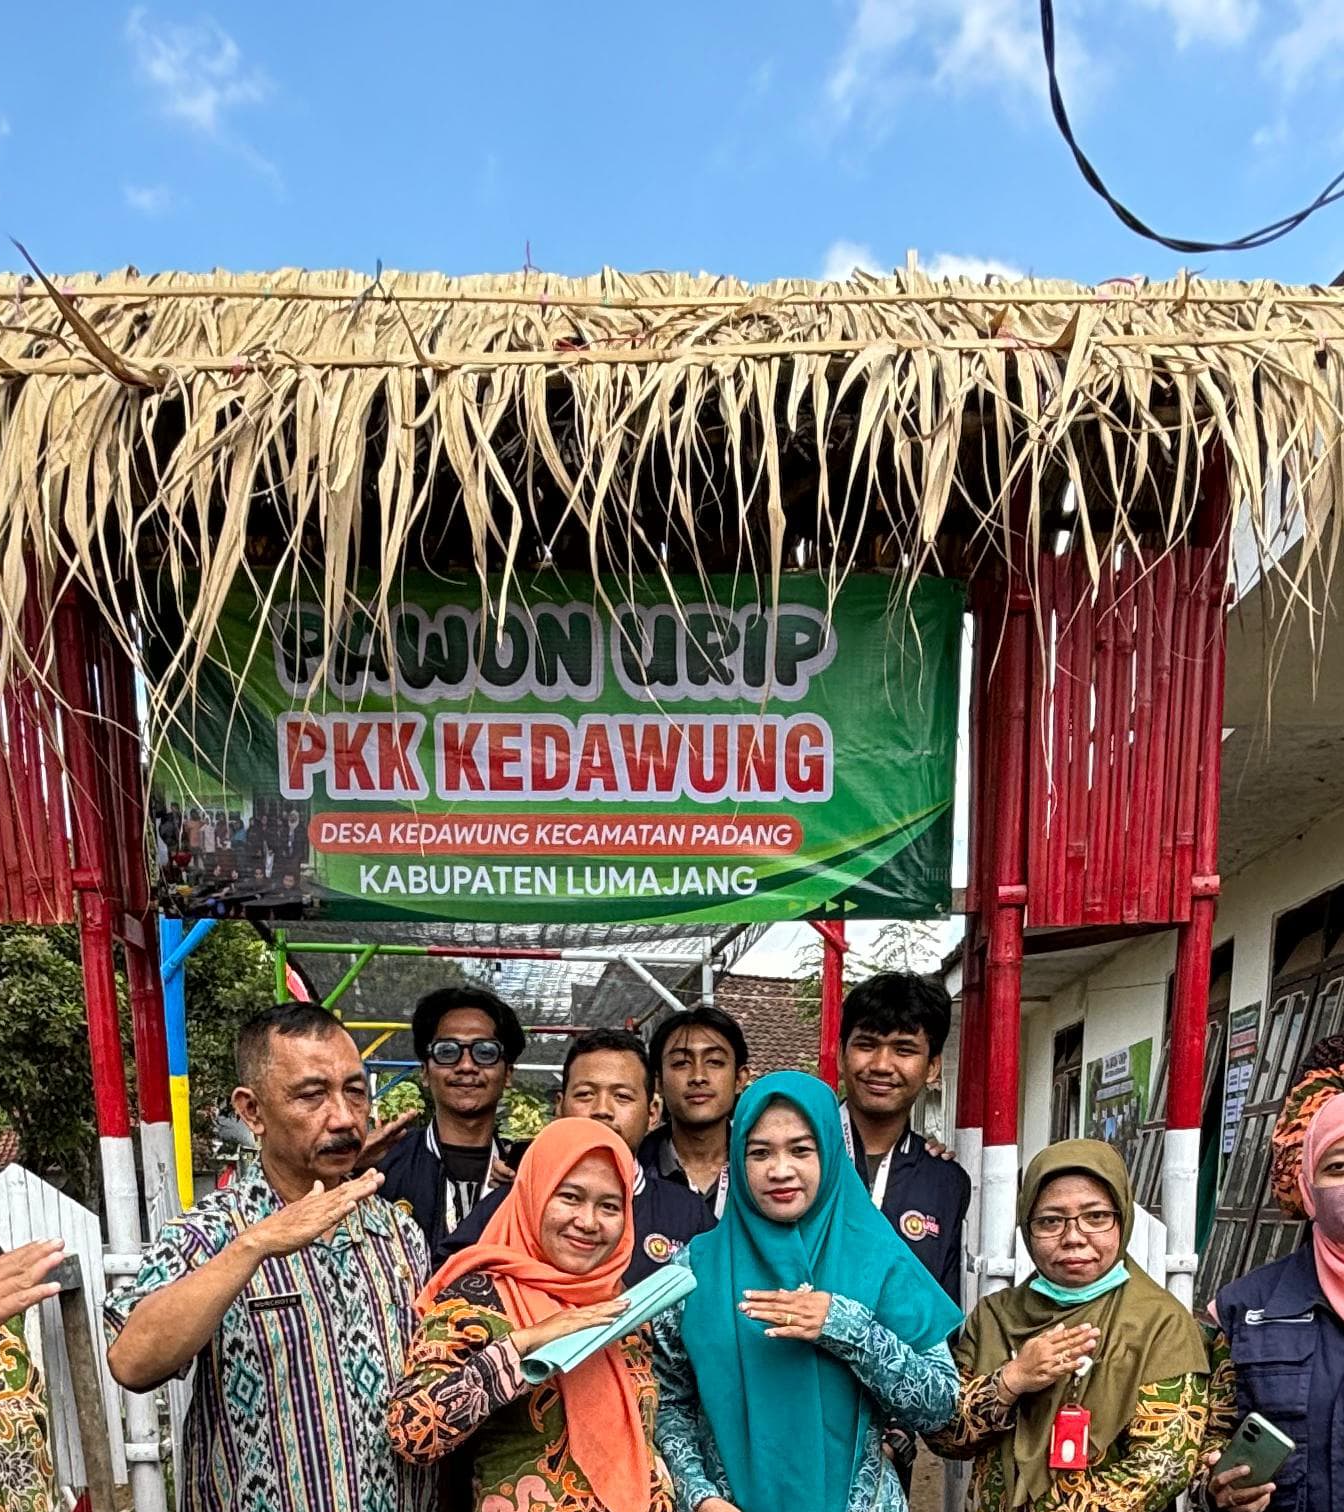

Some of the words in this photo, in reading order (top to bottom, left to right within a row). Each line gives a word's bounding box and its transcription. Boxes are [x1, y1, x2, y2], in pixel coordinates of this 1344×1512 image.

[278, 608, 593, 691] PAWON
[617, 610, 828, 689] URIP
[285, 721, 420, 791] PKK
[442, 721, 825, 793] KEDAWUNG
[320, 821, 383, 844] DESA
[388, 821, 530, 846] KEDAWUNG
[534, 822, 686, 846] KECAMATAN
[690, 823, 794, 846] PADANG
[359, 864, 557, 895] KABUPATEN
[566, 865, 758, 896] LUMAJANG
